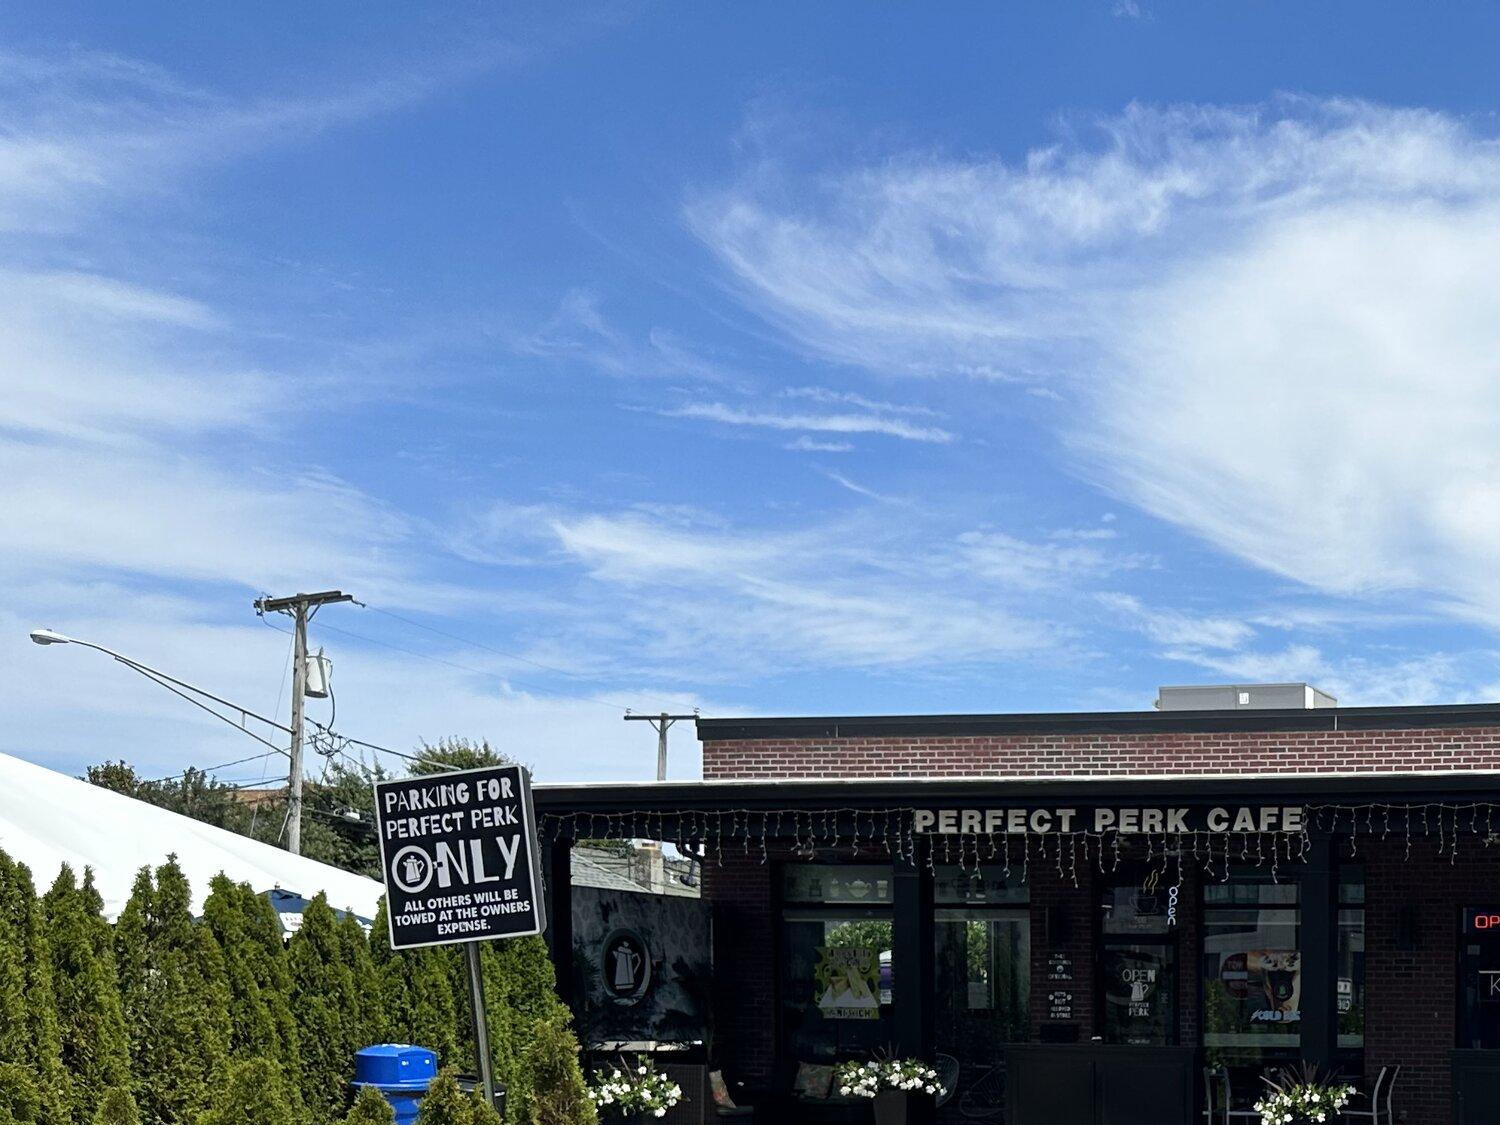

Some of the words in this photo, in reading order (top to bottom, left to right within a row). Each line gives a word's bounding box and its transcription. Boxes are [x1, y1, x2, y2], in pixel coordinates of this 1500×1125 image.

[385, 783, 470, 813] PARKING
[476, 777, 514, 801] FOR
[386, 812, 464, 839] PERFECT
[471, 804, 518, 829] PERK
[915, 808, 1076, 833] PERFECT
[1094, 808, 1189, 833] PERK
[1207, 807, 1302, 832] CAFE
[391, 834, 520, 894] ONLY
[395, 912, 436, 926] TOWED
[439, 910, 453, 922] AT
[456, 907, 478, 919] THE
[482, 900, 531, 916] OWNERS
[404, 900, 424, 912] ALL
[427, 895, 471, 910] OTHERS
[474, 892, 501, 904] WILL
[504, 888, 518, 900] BE
[1122, 969, 1156, 983] OPEN
[1128, 1007, 1150, 1017] PERK
